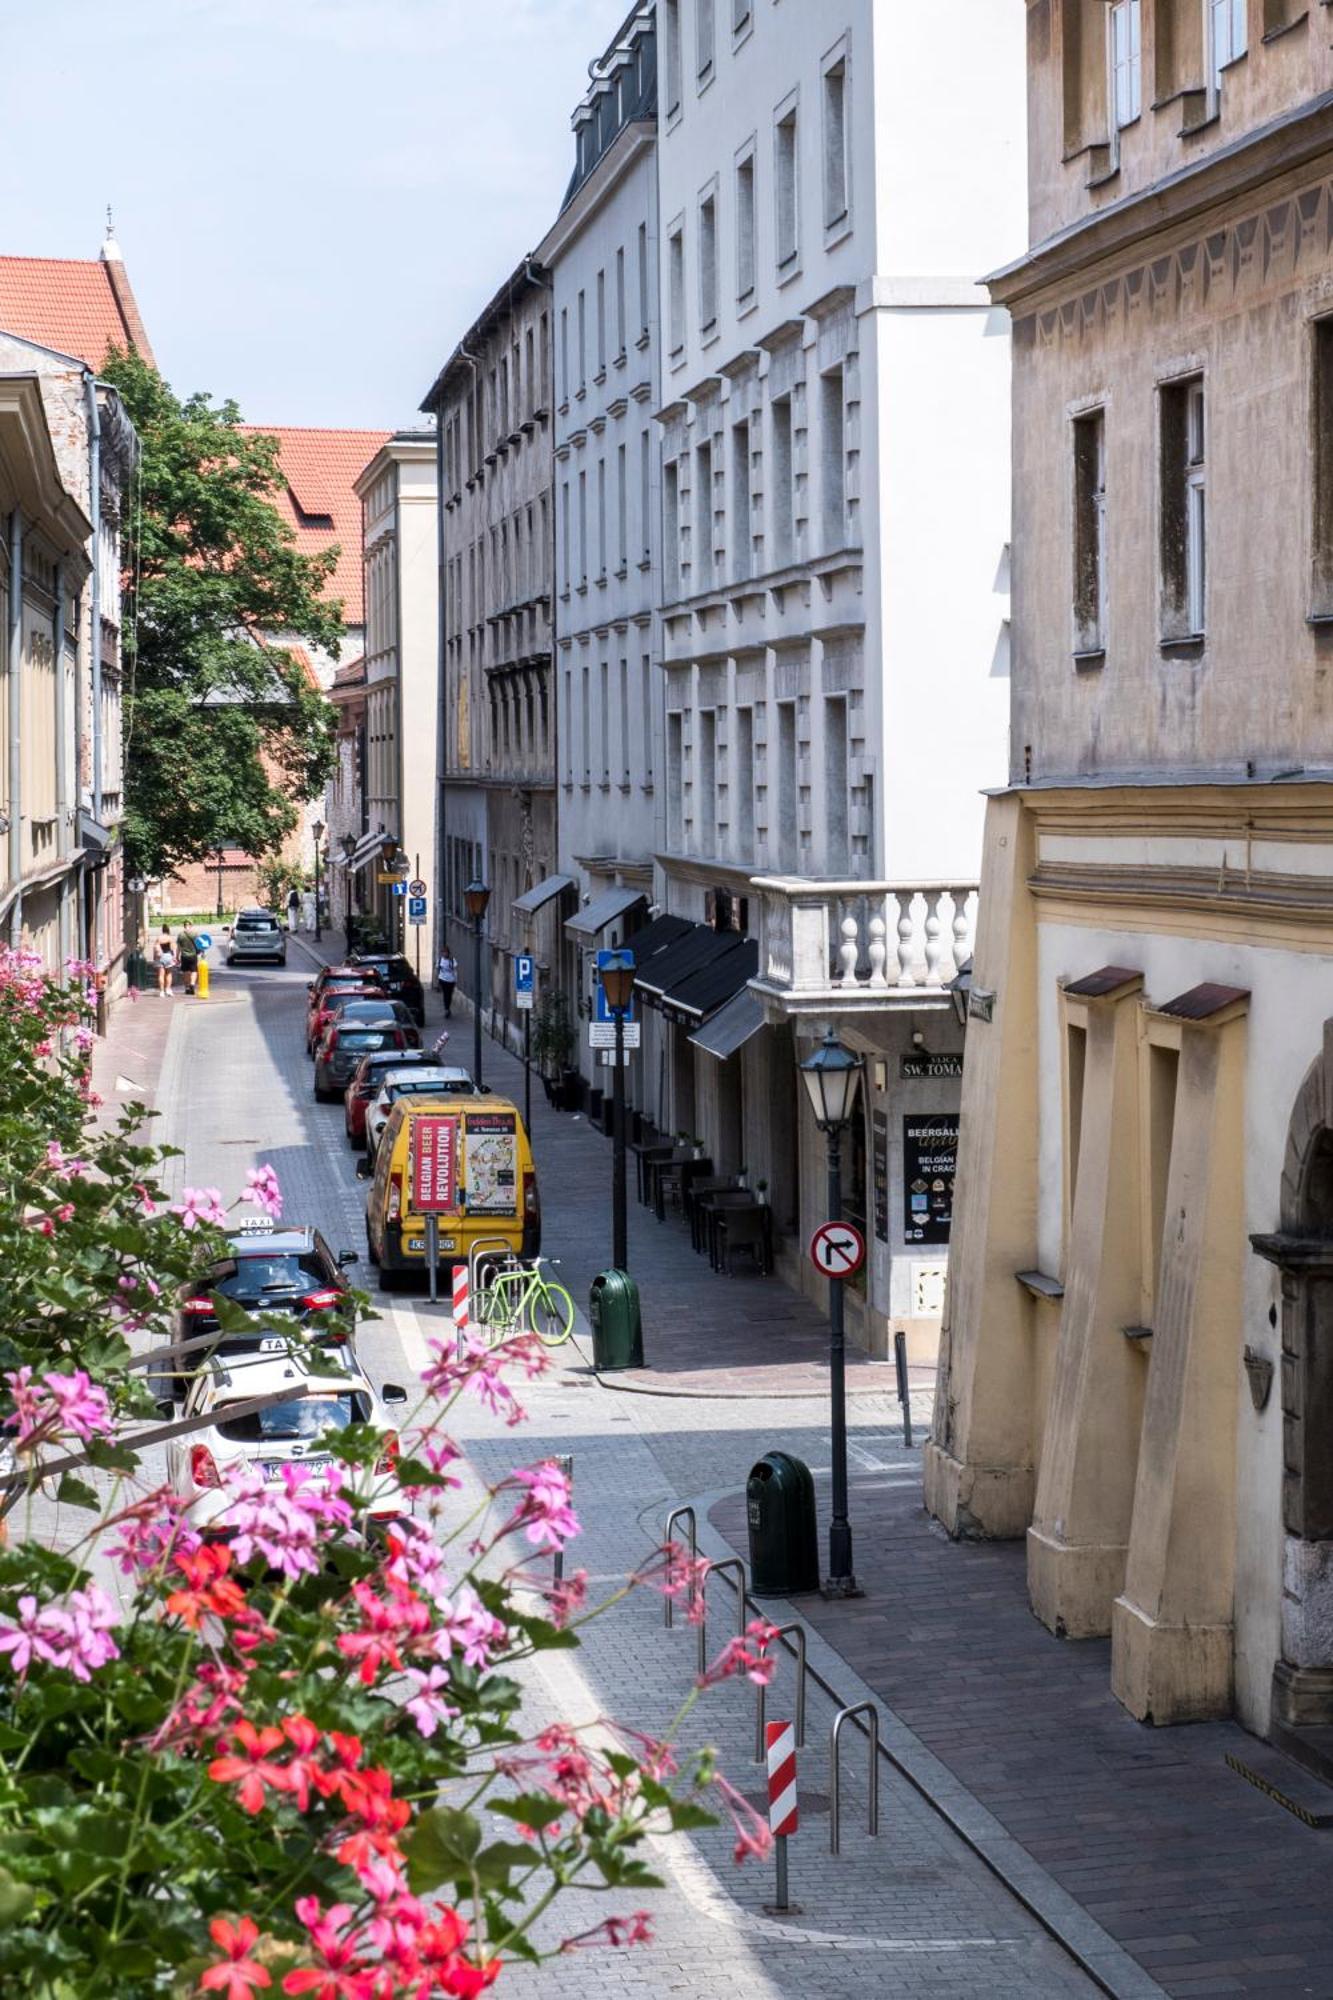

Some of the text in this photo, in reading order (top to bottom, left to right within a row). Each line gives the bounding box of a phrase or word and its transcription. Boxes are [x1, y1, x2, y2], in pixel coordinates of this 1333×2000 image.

[413, 900, 424, 914] P
[519, 959, 530, 980] P
[928, 1063, 962, 1076] TOMA
[421, 1126, 433, 1201] BELGIAN BEER
[436, 1126, 450, 1201] REVOLUTION
[918, 1156, 954, 1165] BELGIAN
[922, 1165, 931, 1173] IN
